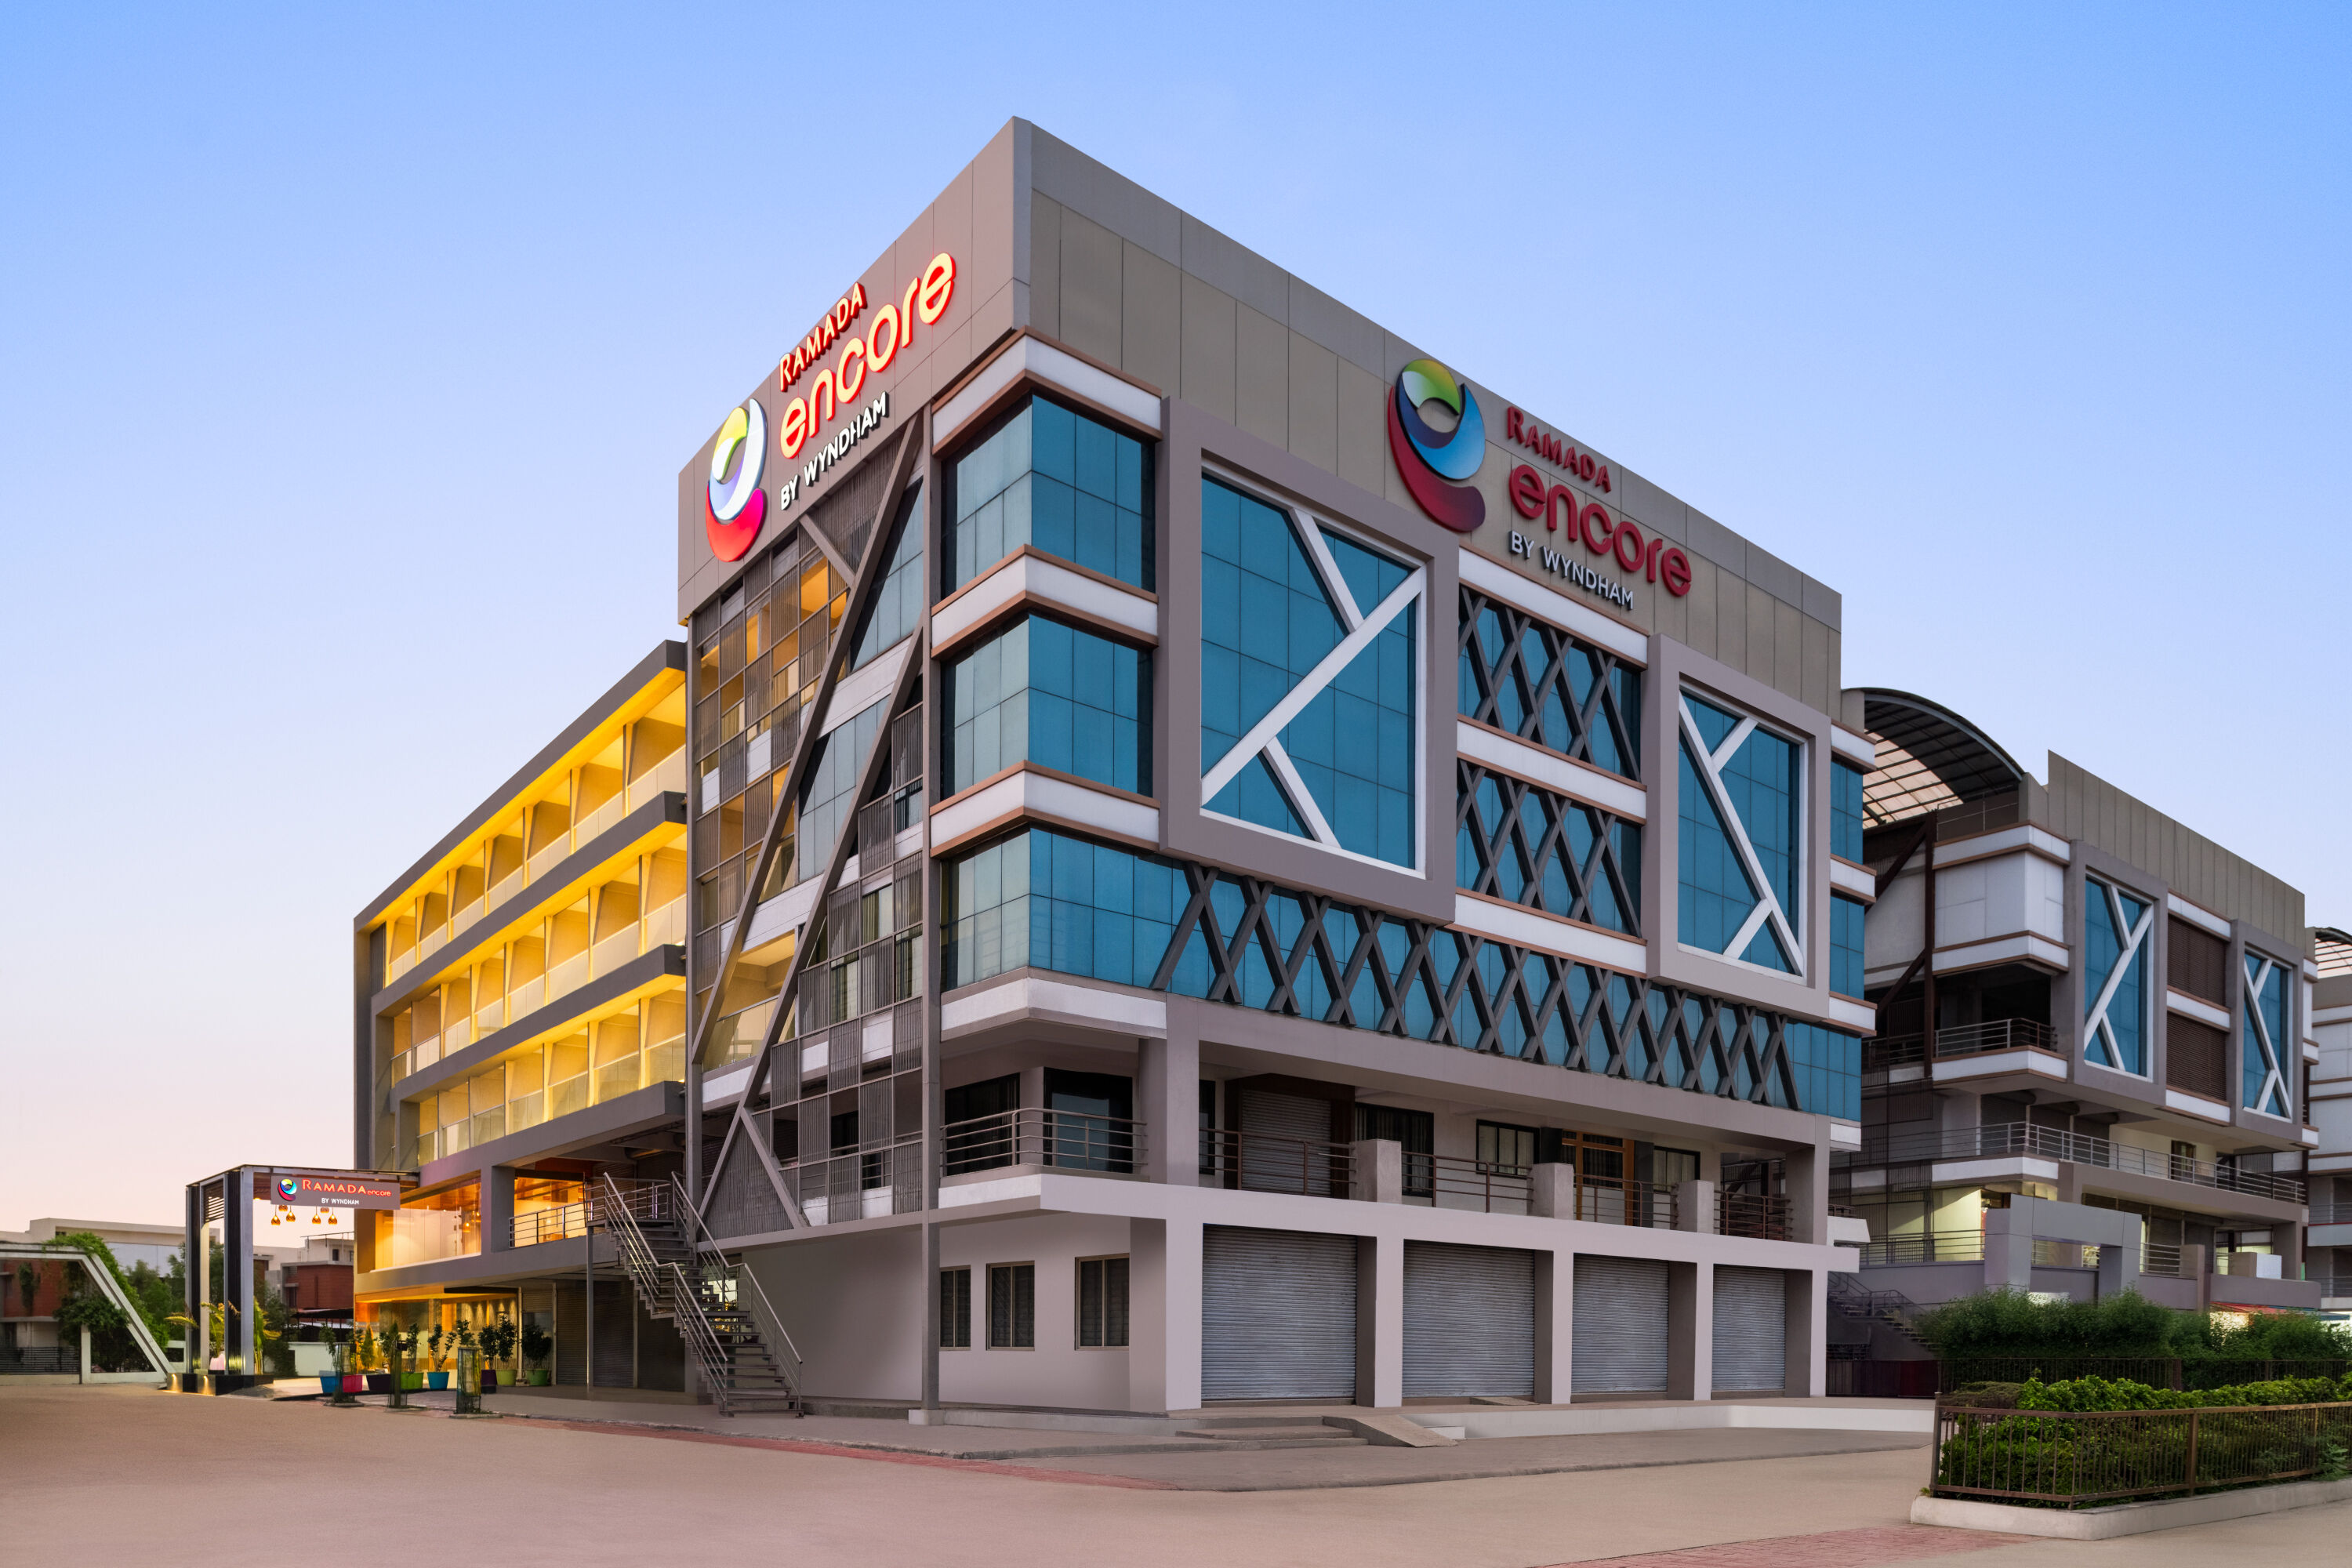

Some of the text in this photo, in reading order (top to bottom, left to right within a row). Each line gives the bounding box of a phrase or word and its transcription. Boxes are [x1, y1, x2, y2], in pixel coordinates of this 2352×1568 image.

[779, 282, 867, 391] RAMADA
[780, 252, 956, 459] encore
[781, 391, 890, 510] BY WYNDHAM
[1507, 405, 1612, 493] RAMADA
[1508, 464, 1692, 597] encore
[1508, 530, 1634, 611] BY WYNDHAM
[302, 1178, 367, 1195] RAMADA
